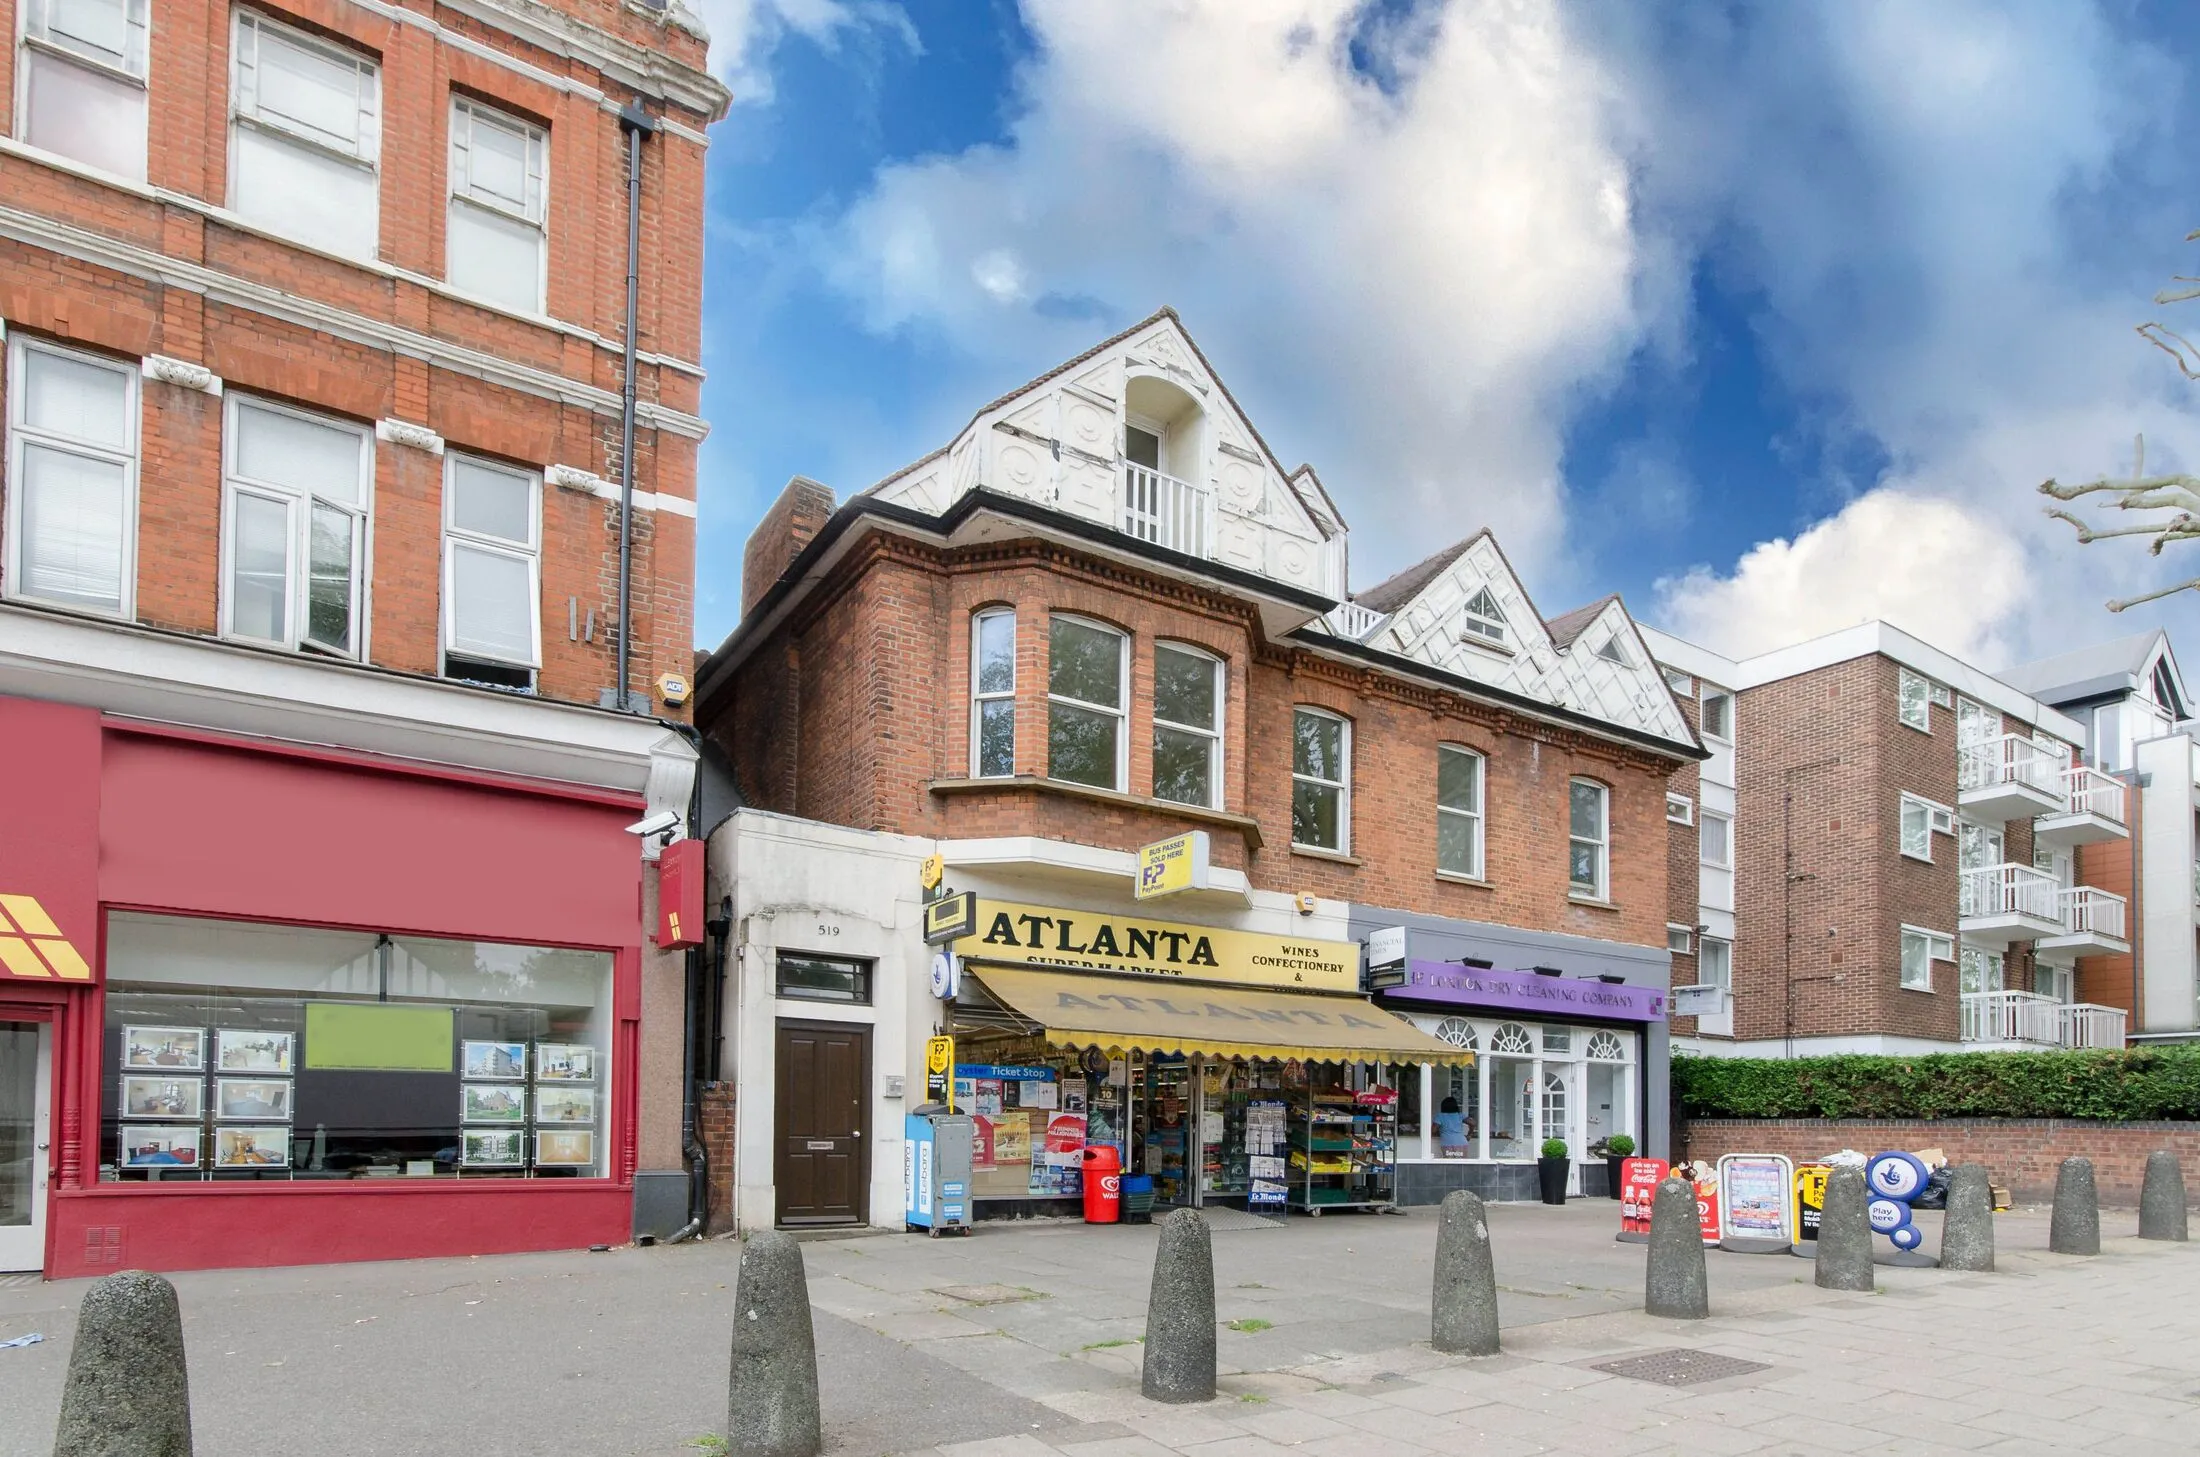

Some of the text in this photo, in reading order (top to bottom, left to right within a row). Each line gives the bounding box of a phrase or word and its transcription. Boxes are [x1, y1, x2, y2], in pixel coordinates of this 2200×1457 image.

[667, 681, 683, 693] ADT
[1149, 840, 1185, 856] BUS PASSES
[1150, 848, 1184, 864] SOLD HERE
[819, 925, 840, 937] 519
[982, 912, 1219, 967] ATLANTA
[1281, 945, 1320, 958] WINES
[1252, 955, 1344, 973] CONFECTIONERY
[1294, 972, 1303, 982] &
[1430, 974, 1483, 991] LONDON
[1489, 980, 1513, 996] DRY
[1517, 984, 1577, 1002] CLEANING
[1582, 991, 1634, 1008] COMPANY
[1056, 991, 1387, 1030] ATLANTA
[991, 1066, 1021, 1077] Ticket
[1023, 1067, 1046, 1079] Stop
[1101, 1090, 1113, 1099] 10
[1259, 1192, 1286, 1201] Monde
[1872, 1207, 1893, 1216] Play
[1872, 1214, 1894, 1222] here
